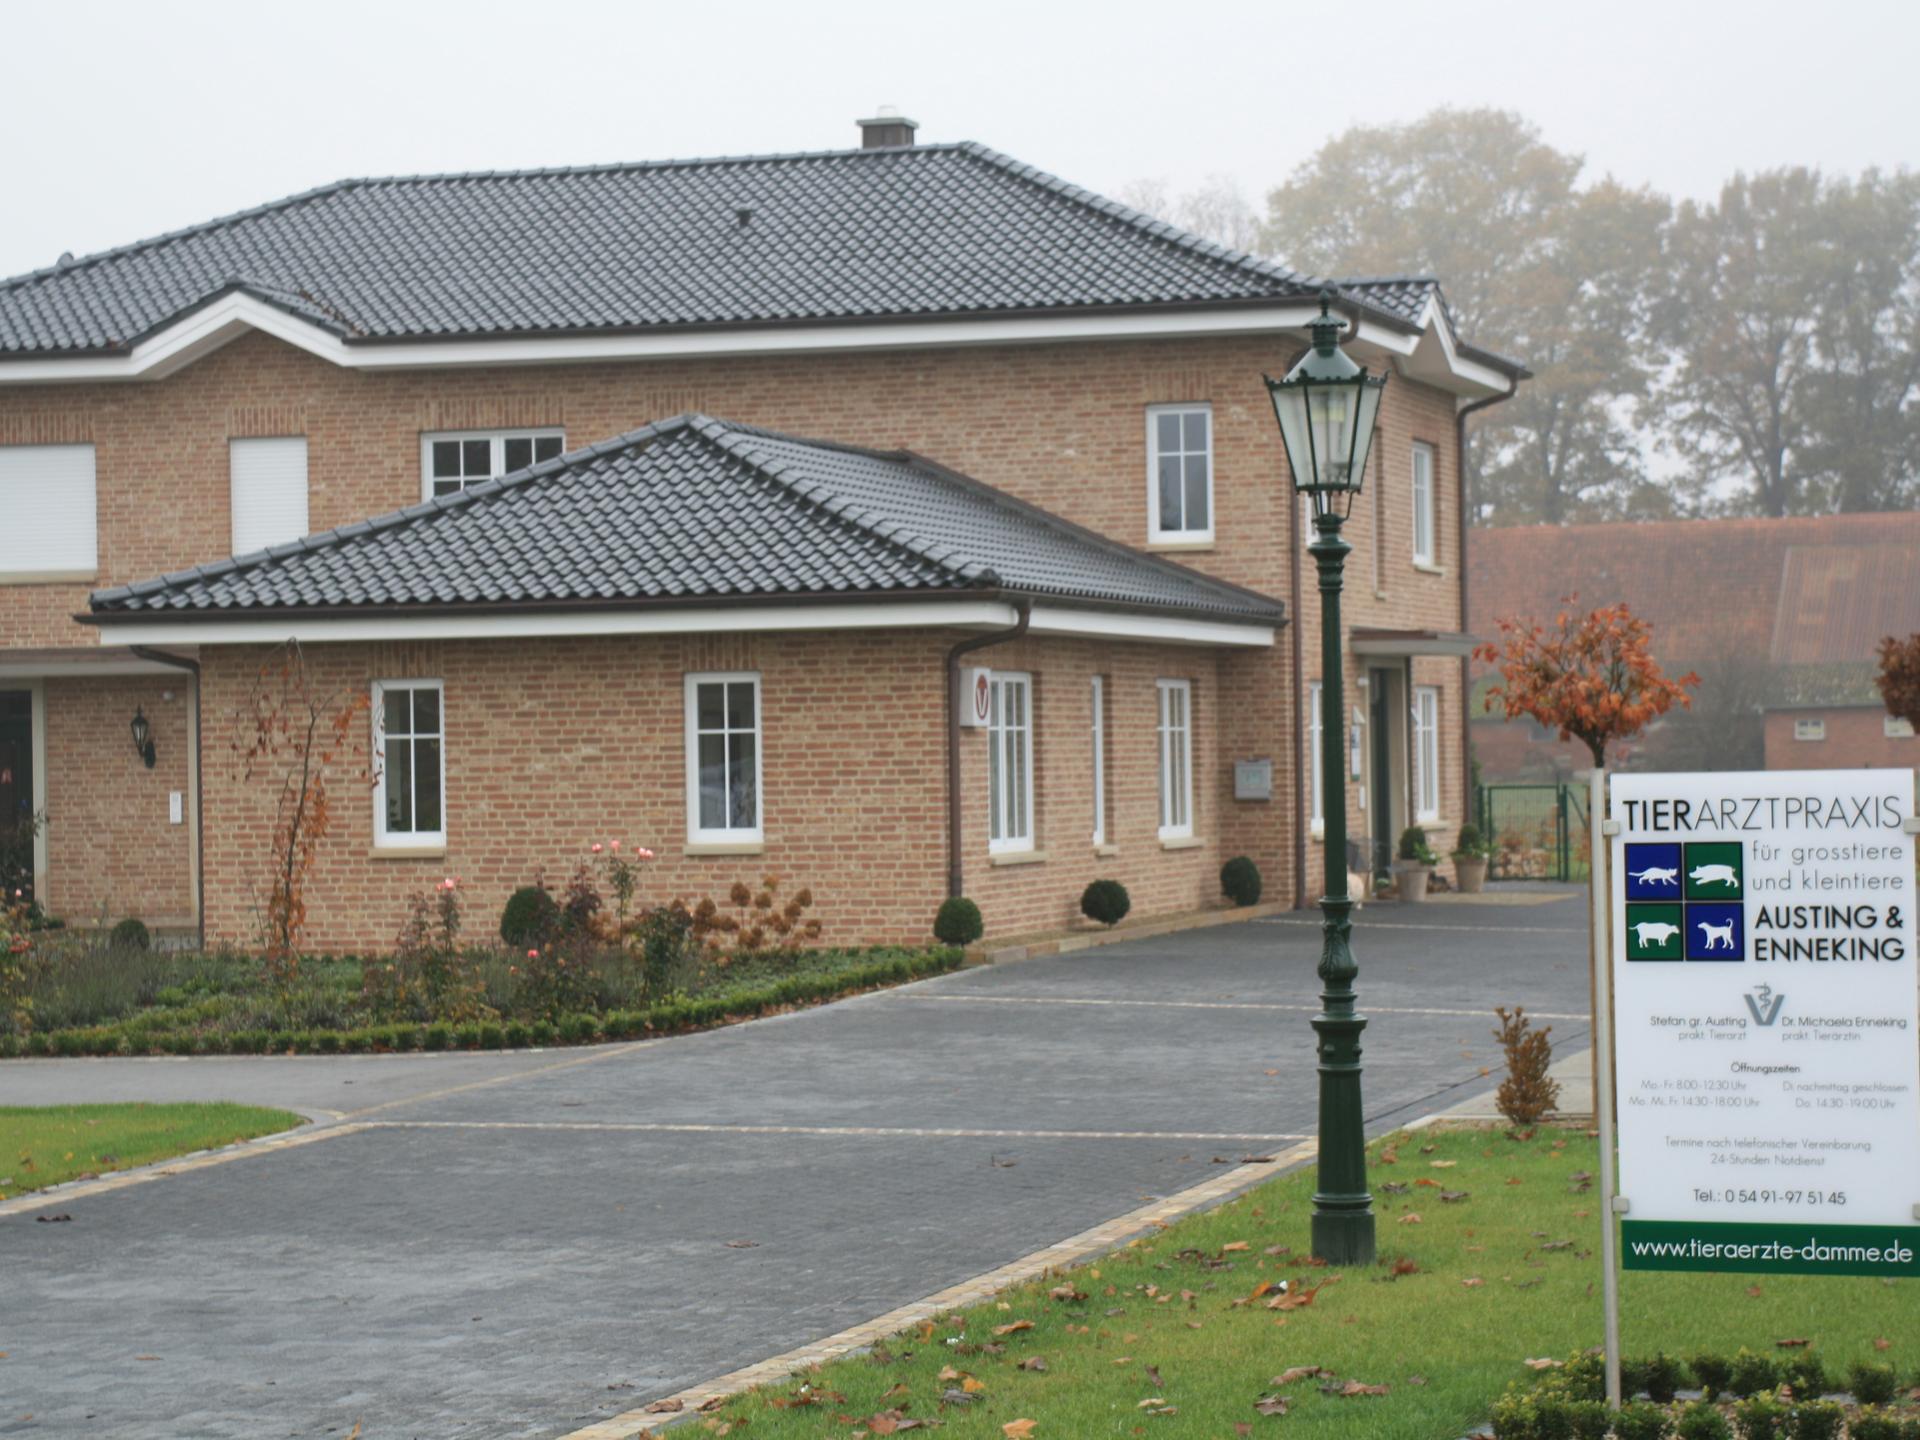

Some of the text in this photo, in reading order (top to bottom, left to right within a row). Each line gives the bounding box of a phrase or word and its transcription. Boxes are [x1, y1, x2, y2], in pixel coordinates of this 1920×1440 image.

[1623, 796, 1901, 831] TIERARZTPRAXIS
[1752, 840, 1902, 865] für grosstiere
[1752, 870, 1903, 890] und kleintiere
[1755, 906, 1904, 929] AUSTING &
[1755, 938, 1905, 962] ENNEKING
[1650, 1016, 1685, 1026] Stefan
[1705, 1016, 1747, 1029] Austing
[1781, 1016, 1907, 1029] Dr. Michaela Enneking
[1709, 1029, 1747, 1041] Tierarzt
[1730, 1080, 1747, 1091] Uhr
[1796, 1082, 1849, 1093] nachmittag
[1852, 1082, 1908, 1094] geschlossen
[1744, 1096, 1760, 1107] Uhr
[1880, 1098, 1896, 1109] Uhr
[1665, 1136, 1872, 1152] Termine nach telefonischer Vereinbarung
[1774, 1154, 1826, 1166] Notdienst
[1693, 1189, 1721, 1202] Tel.:
[1631, 1238, 1913, 1263] www.tieraerzte-damme.de
